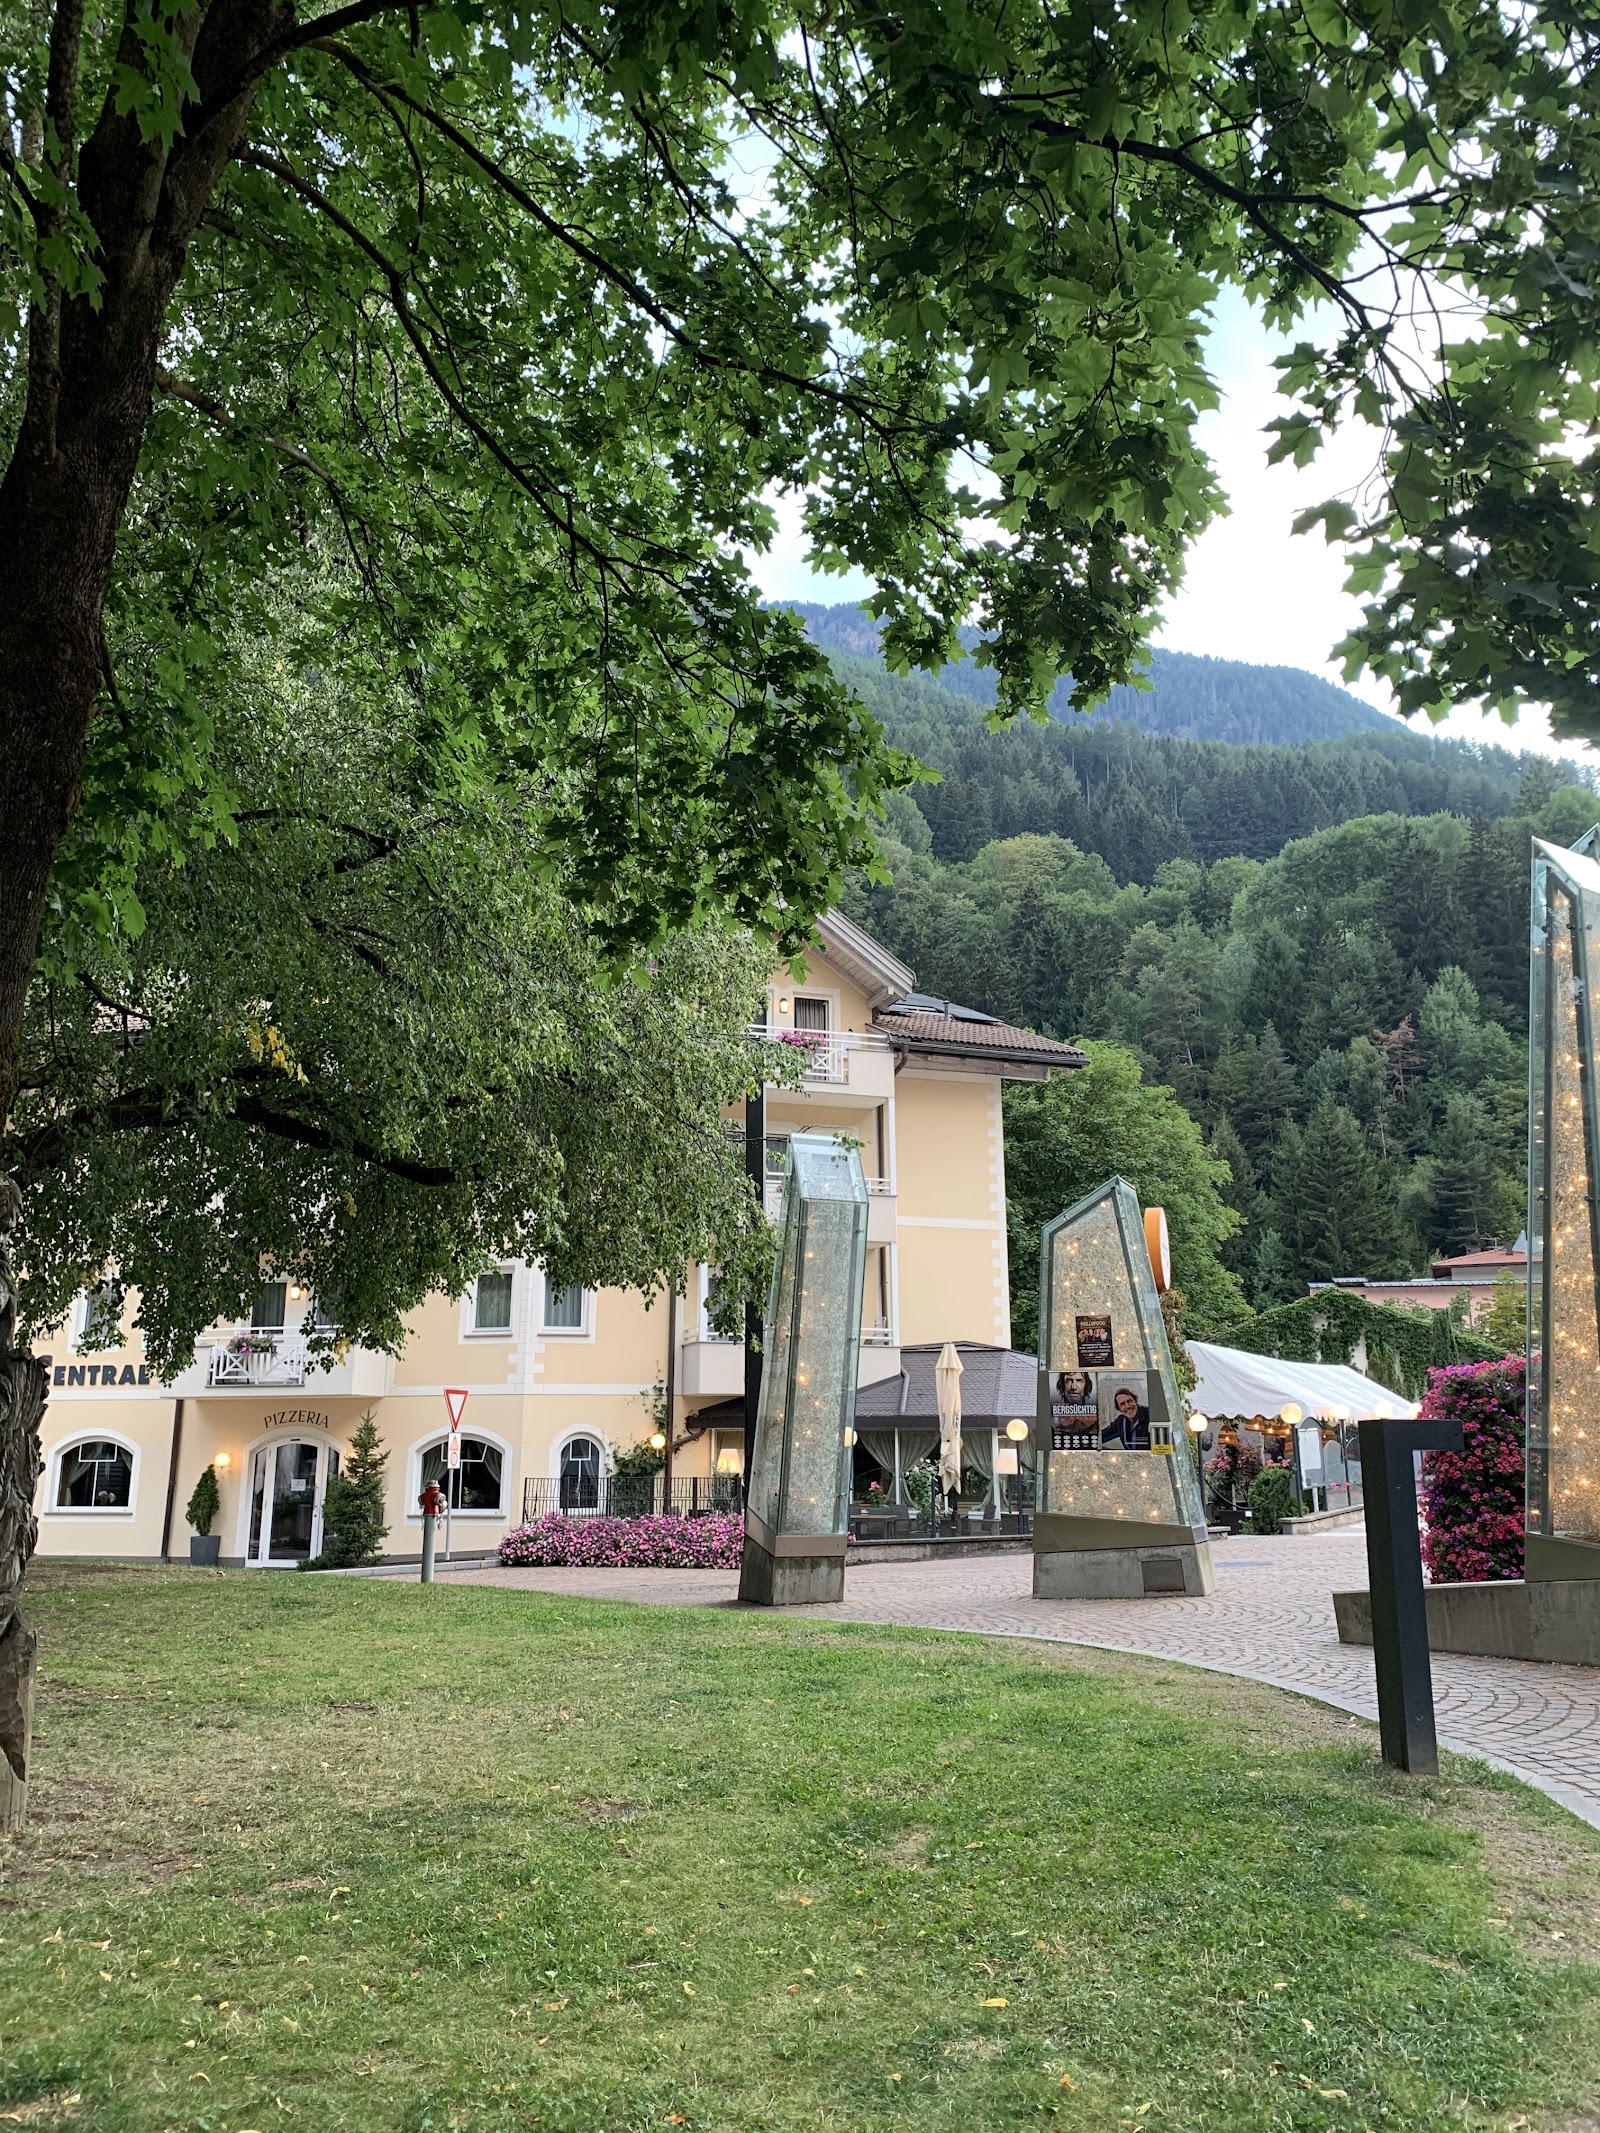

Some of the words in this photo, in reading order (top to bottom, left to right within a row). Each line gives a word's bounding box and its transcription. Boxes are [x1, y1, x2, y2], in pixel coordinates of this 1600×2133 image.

[44, 1365, 150, 1386] ENTRAL
[263, 1409, 329, 1429] PIZZERIA
[1052, 1404, 1098, 1415] BERGSÜCHTIG
